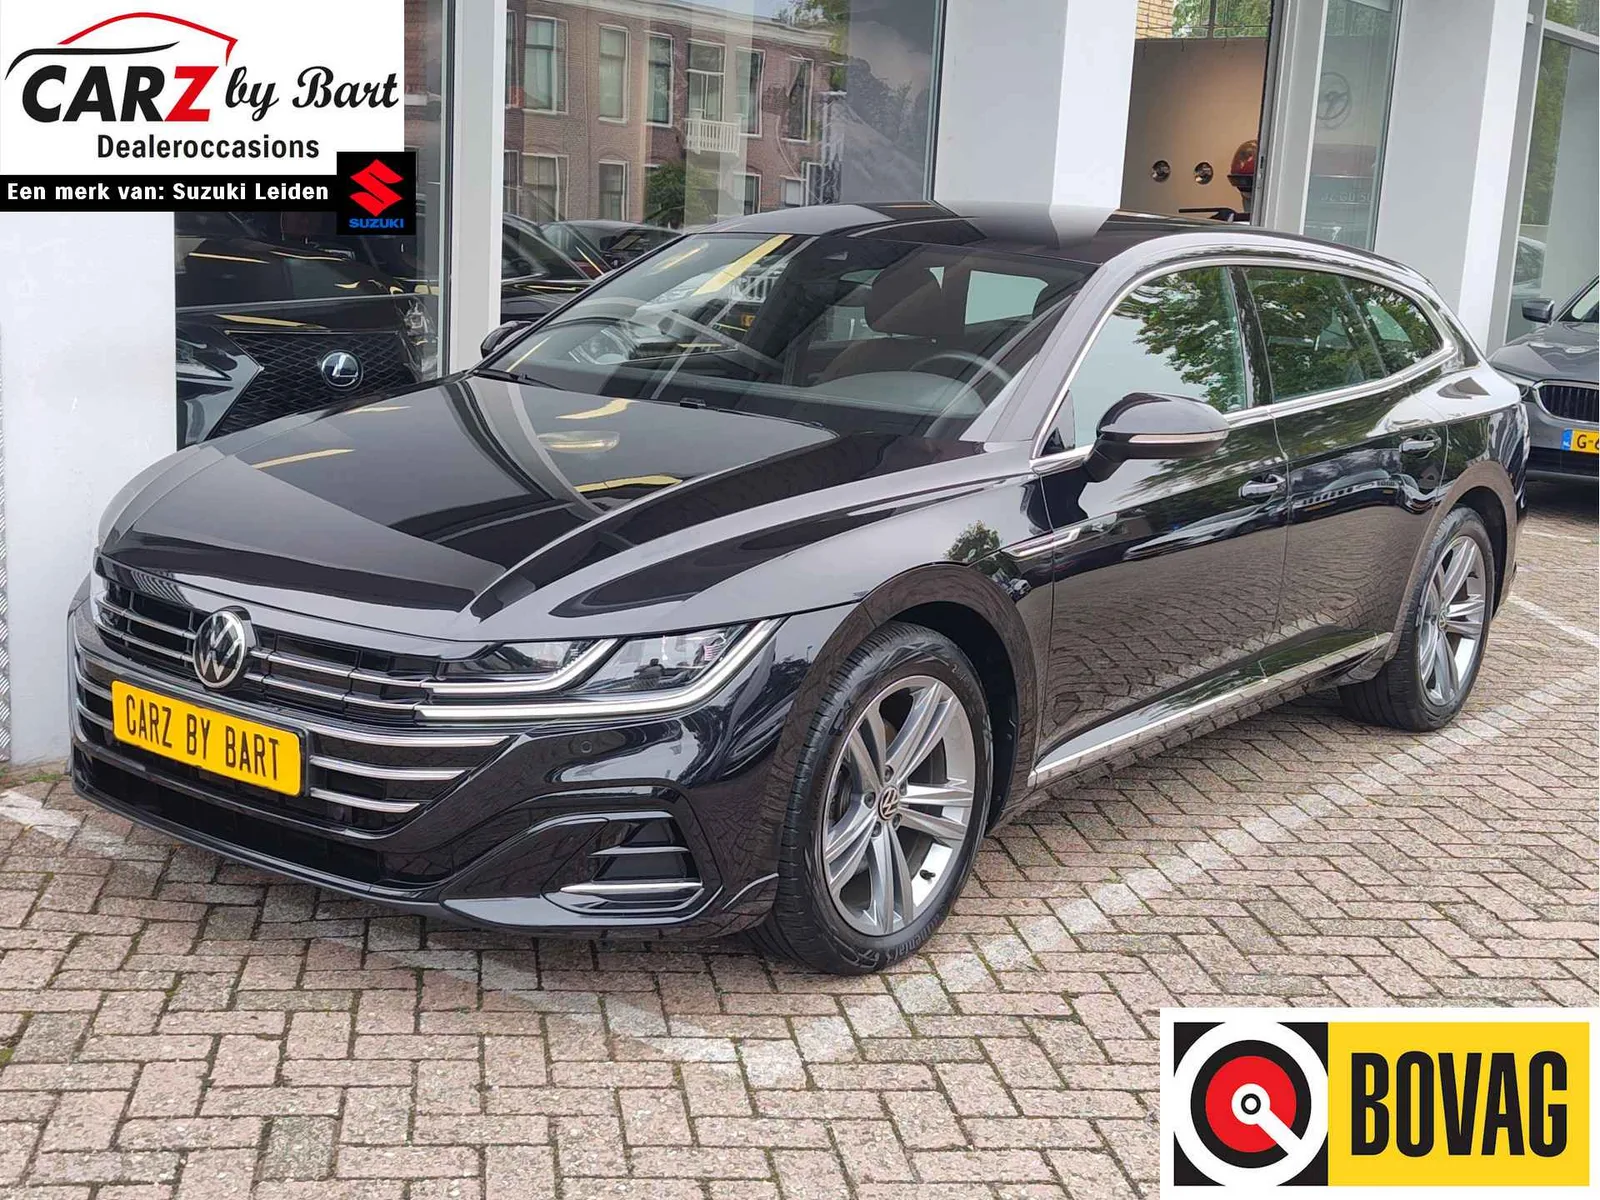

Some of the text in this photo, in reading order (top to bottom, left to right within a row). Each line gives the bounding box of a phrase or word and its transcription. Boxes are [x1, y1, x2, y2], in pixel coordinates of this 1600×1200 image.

[125, 694, 279, 780] CARZ BY BART
